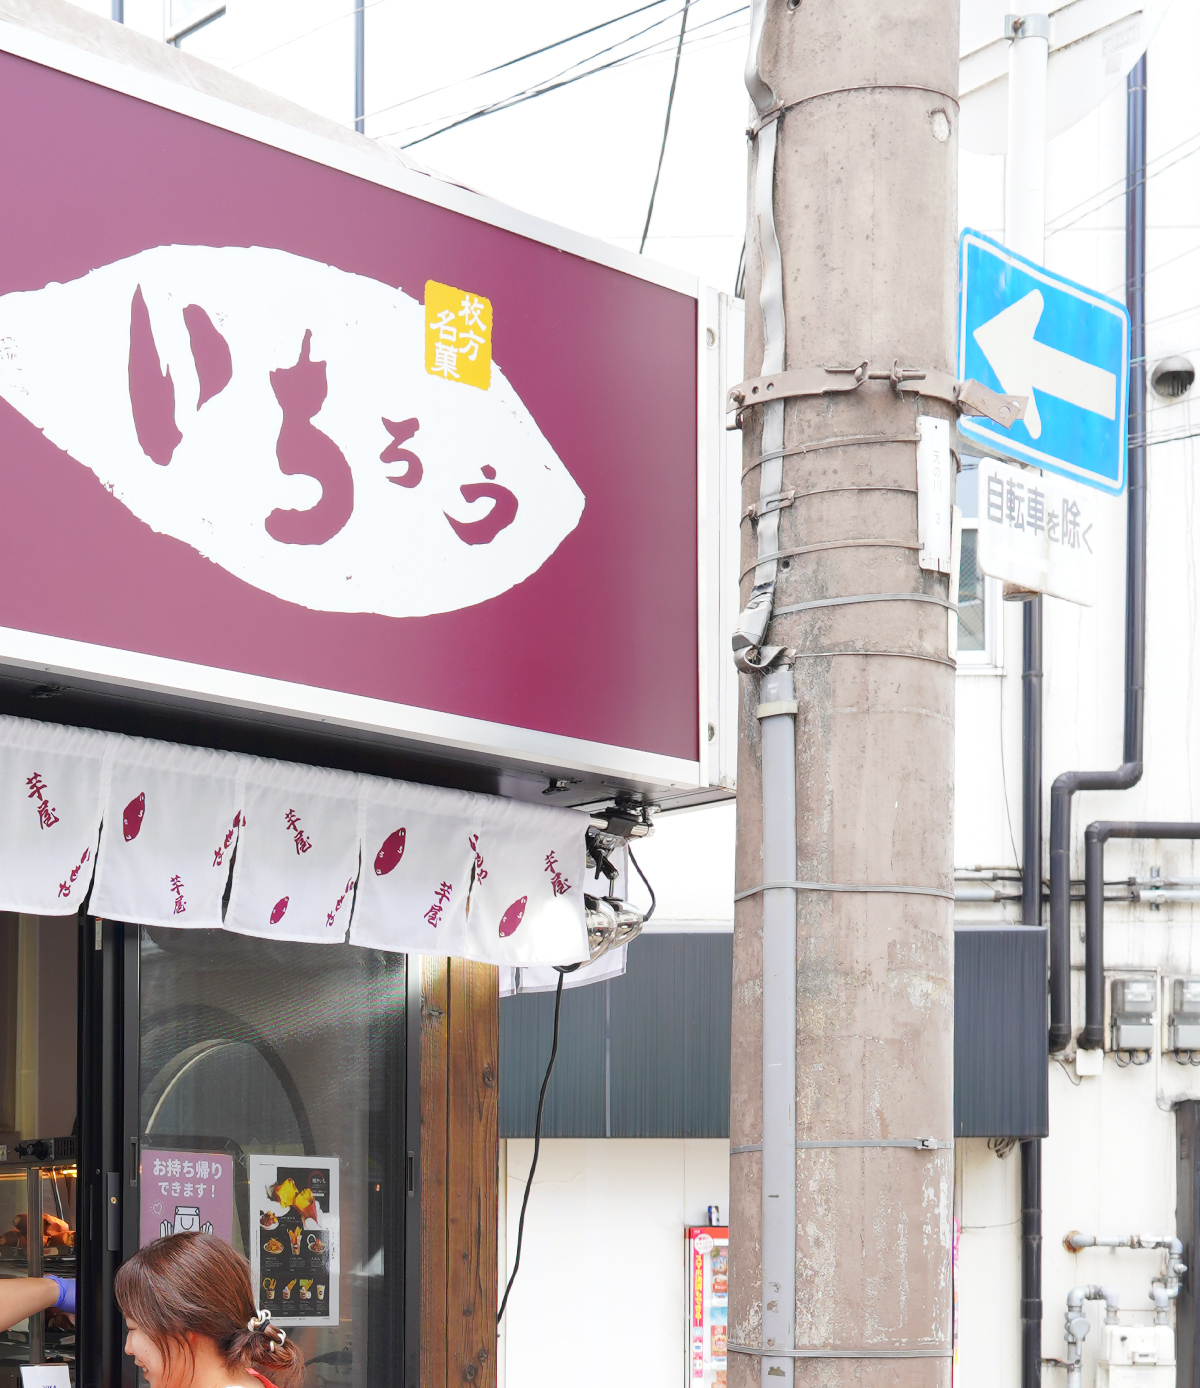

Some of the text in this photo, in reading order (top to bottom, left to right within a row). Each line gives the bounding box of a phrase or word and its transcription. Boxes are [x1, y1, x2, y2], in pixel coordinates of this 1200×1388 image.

[429, 309, 460, 379] 名菓
[458, 294, 487, 362] 枚方
[128, 282, 519, 546] いちろう
[987, 472, 1094, 554] 自転車を除く
[26, 772, 59, 830] 芋屋
[153, 1158, 223, 1180] お持ち帰り
